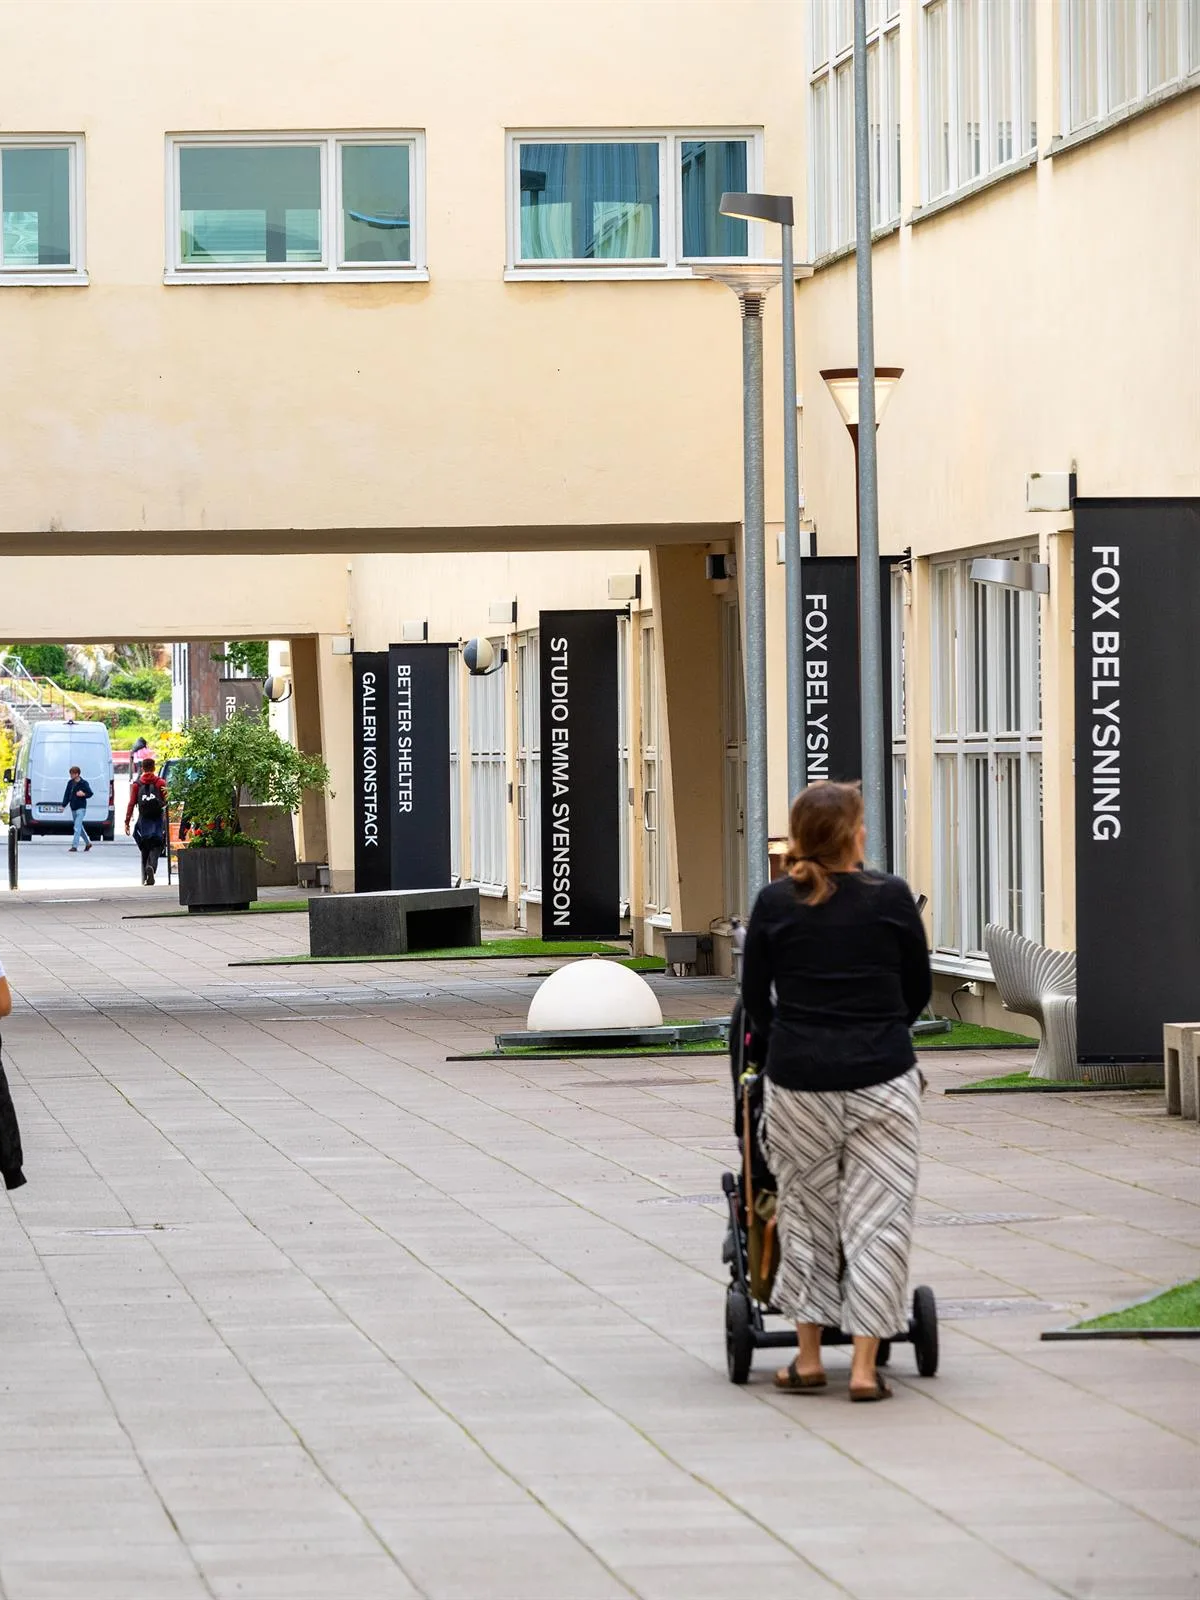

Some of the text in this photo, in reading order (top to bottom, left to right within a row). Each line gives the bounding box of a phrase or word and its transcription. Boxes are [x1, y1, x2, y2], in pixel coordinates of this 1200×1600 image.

[362, 672, 378, 847] GALLERI KONSTFACK
[397, 665, 413, 813] BETTER SHELTER
[805, 594, 829, 780] FOX BELYSNI
[1091, 546, 1122, 841] FOX BELYSNING
[551, 637, 570, 927] STUDIO EMMA SVENSSON
